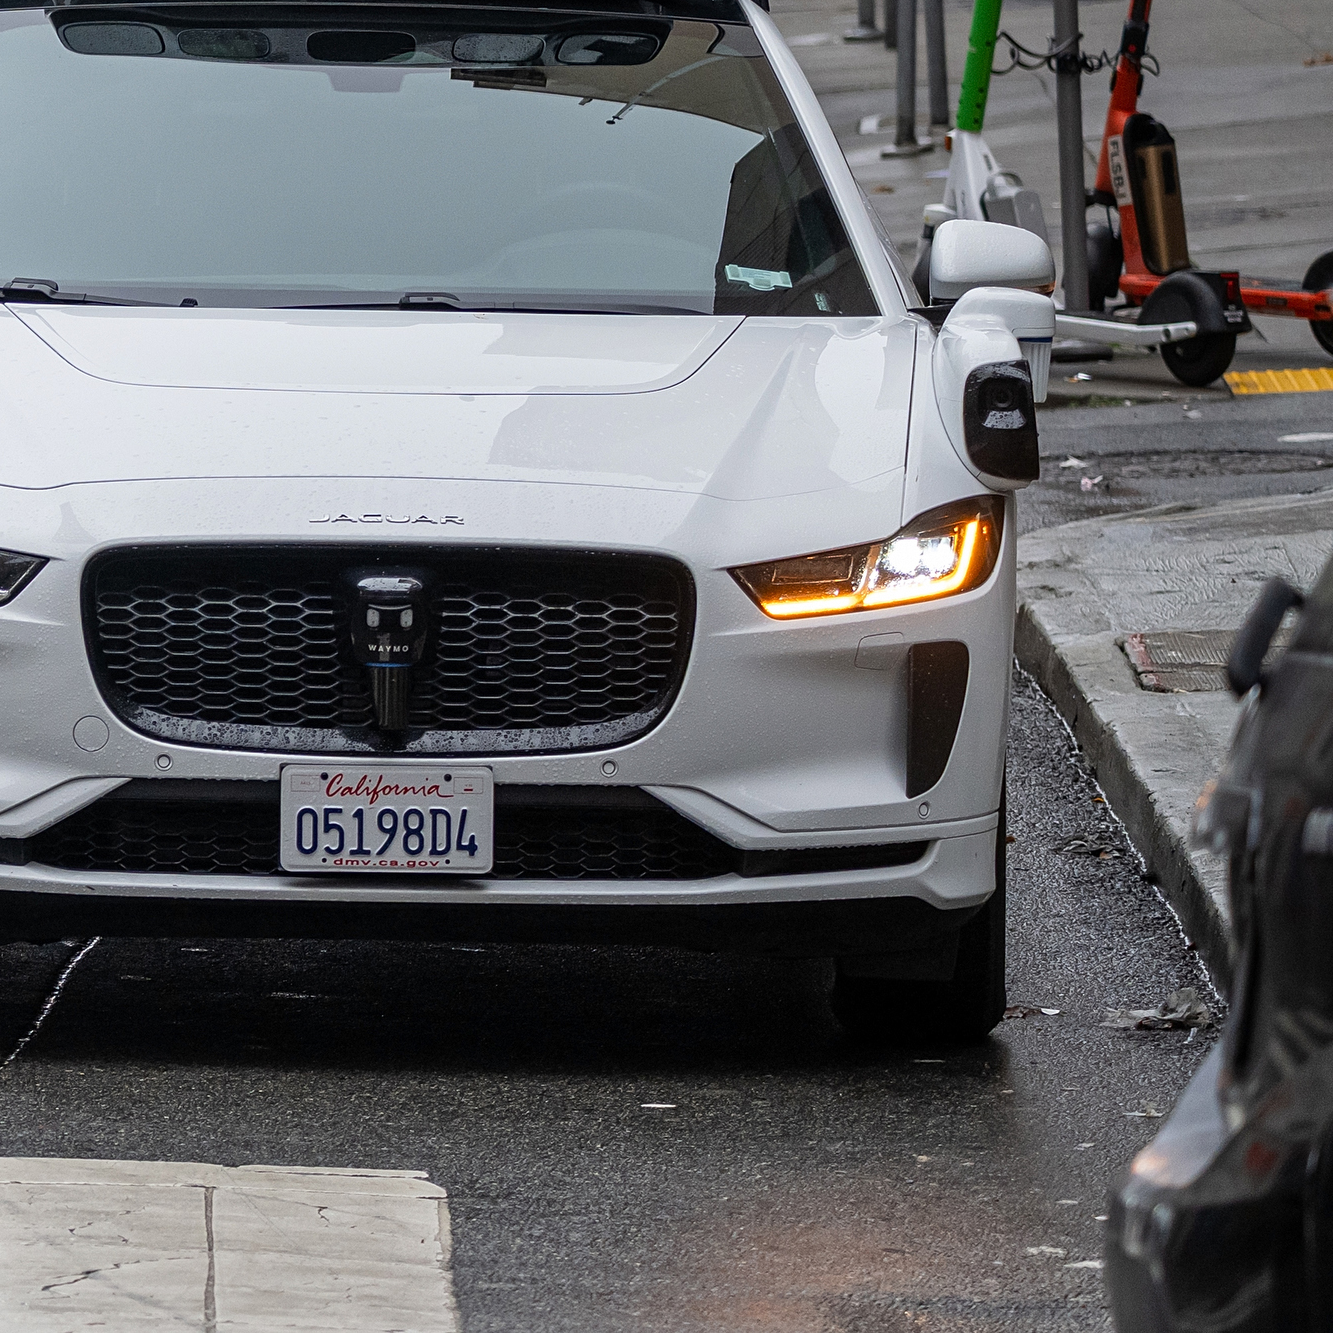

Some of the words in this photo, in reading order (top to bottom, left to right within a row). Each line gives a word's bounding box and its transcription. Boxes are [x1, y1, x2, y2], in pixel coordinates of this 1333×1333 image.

[309, 513, 465, 525] JAGUAR
[368, 643, 409, 653] WAYMO
[325, 772, 454, 805] California
[295, 806, 479, 857] 05198D4
[333, 857, 440, 868] dmv.ca.gov
